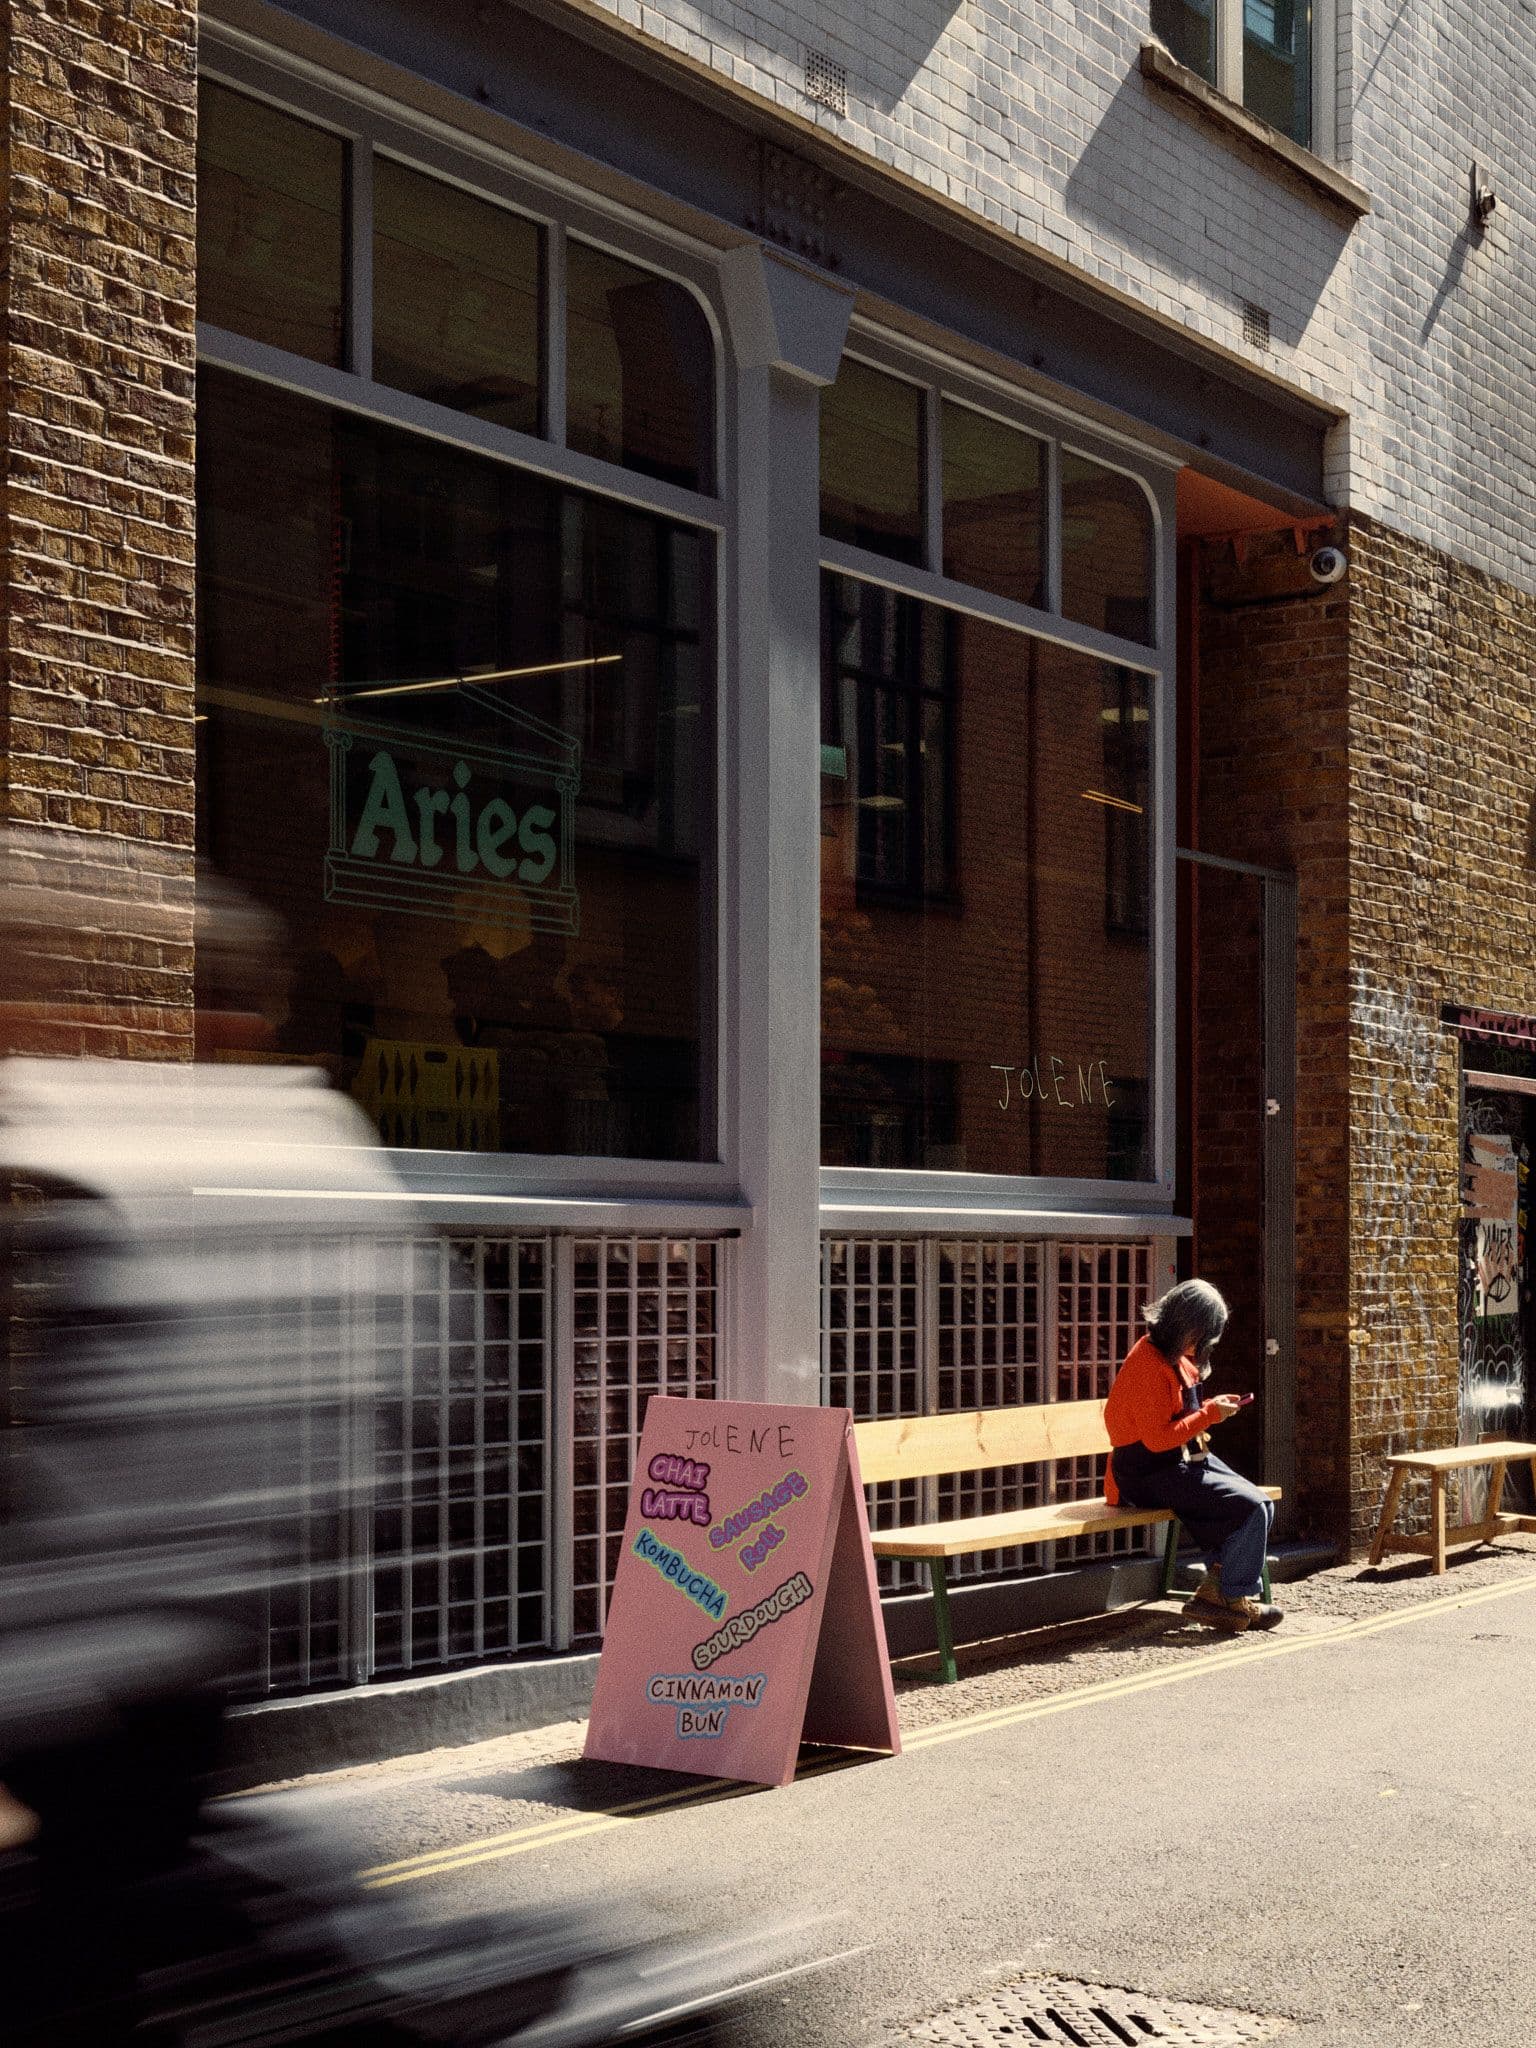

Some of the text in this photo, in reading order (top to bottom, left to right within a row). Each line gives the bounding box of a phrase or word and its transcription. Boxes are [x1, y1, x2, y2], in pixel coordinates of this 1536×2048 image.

[351, 750, 557, 883] Aries
[990, 1055, 1116, 1110] JOLENE
[686, 1425, 795, 1457] JOLENE
[650, 1456, 708, 1488] CHAI
[643, 1492, 709, 1523] LATTE
[710, 1472, 808, 1547] SAUSAGE
[740, 1524, 785, 1570] ROLL
[635, 1531, 727, 1616] KOMBUCHA
[694, 1576, 812, 1665] SOURDOUGH
[650, 1678, 761, 1701] CINNAMON
[681, 1710, 723, 1733] BUN
